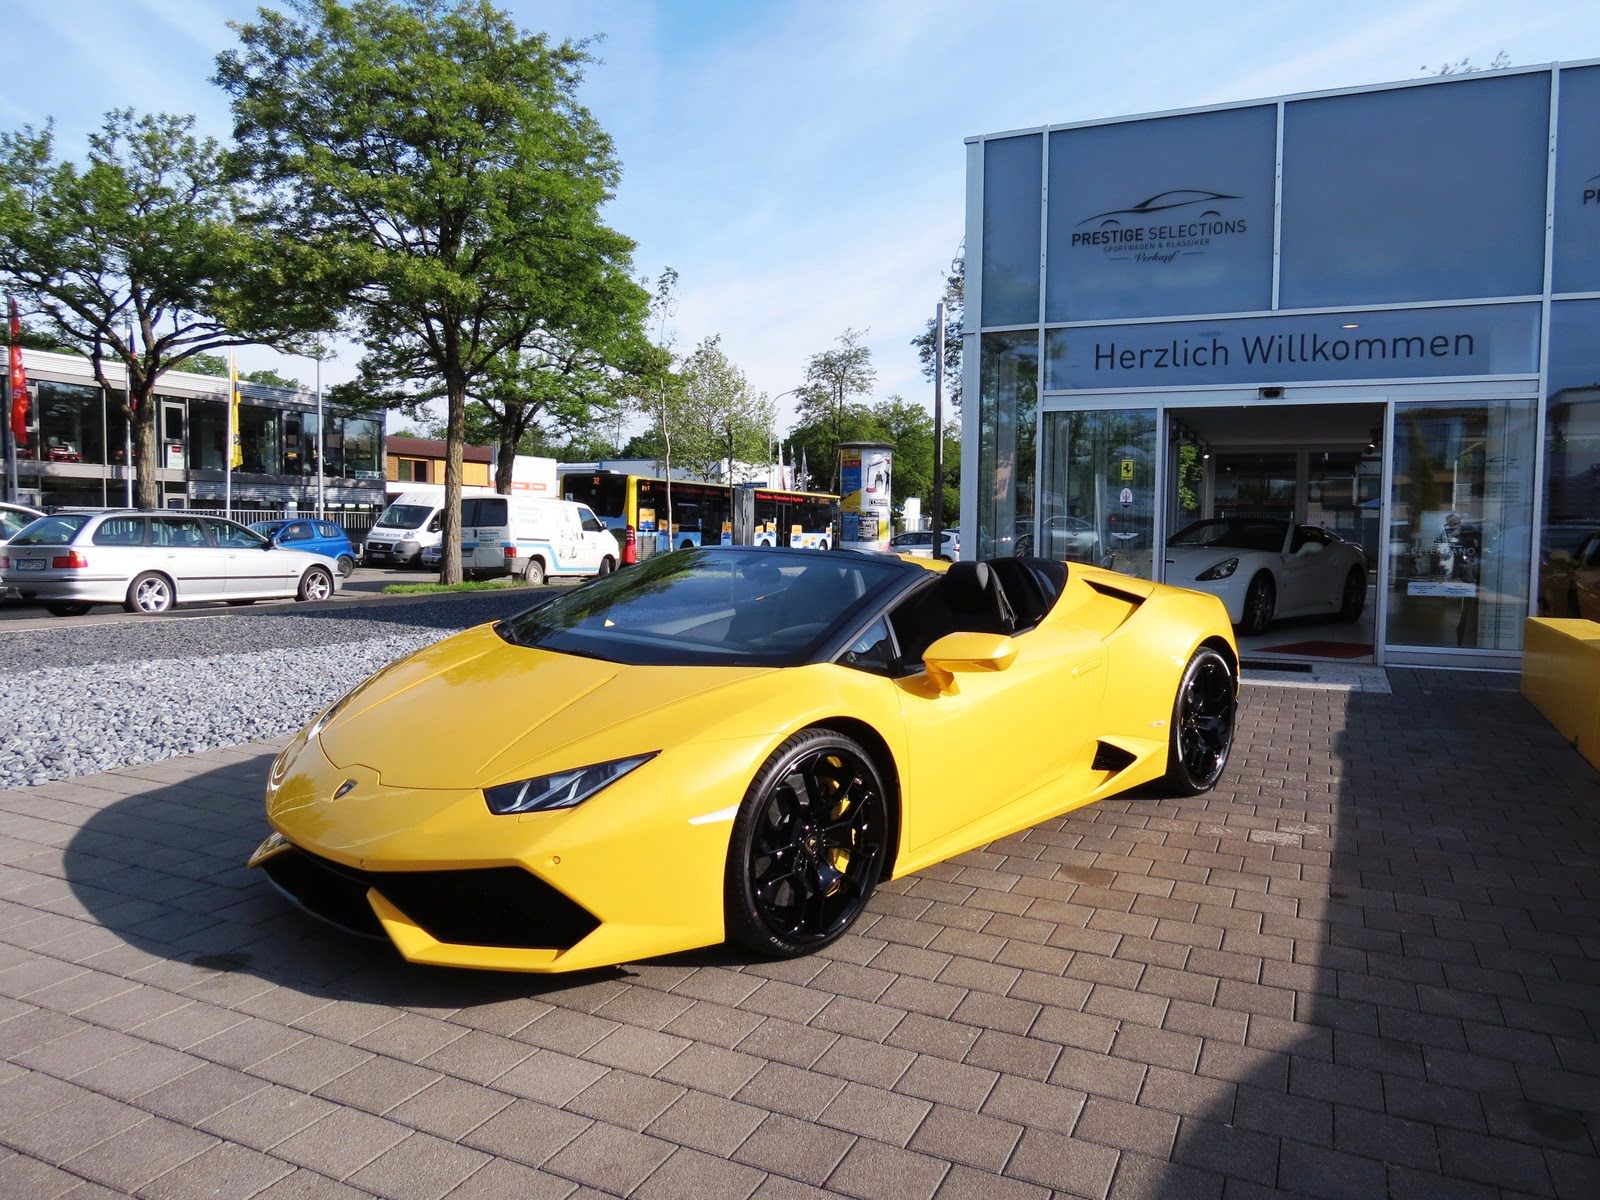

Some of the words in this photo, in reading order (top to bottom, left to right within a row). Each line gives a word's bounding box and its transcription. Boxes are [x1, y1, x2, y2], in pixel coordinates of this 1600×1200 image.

[1583, 189, 1600, 205] P
[1071, 228, 1144, 246] PRESTIGE
[1148, 220, 1246, 240] SELECTIONS
[1103, 243, 1155, 253] SPORTWAGEN
[1158, 241, 1163, 249] &
[1166, 238, 1210, 247] KLASSIKER
[1134, 251, 1180, 264] Verkauf
[1095, 339, 1229, 370] Herzlich
[1242, 333, 1474, 365] Willkommen
[593, 476, 600, 485] 32
